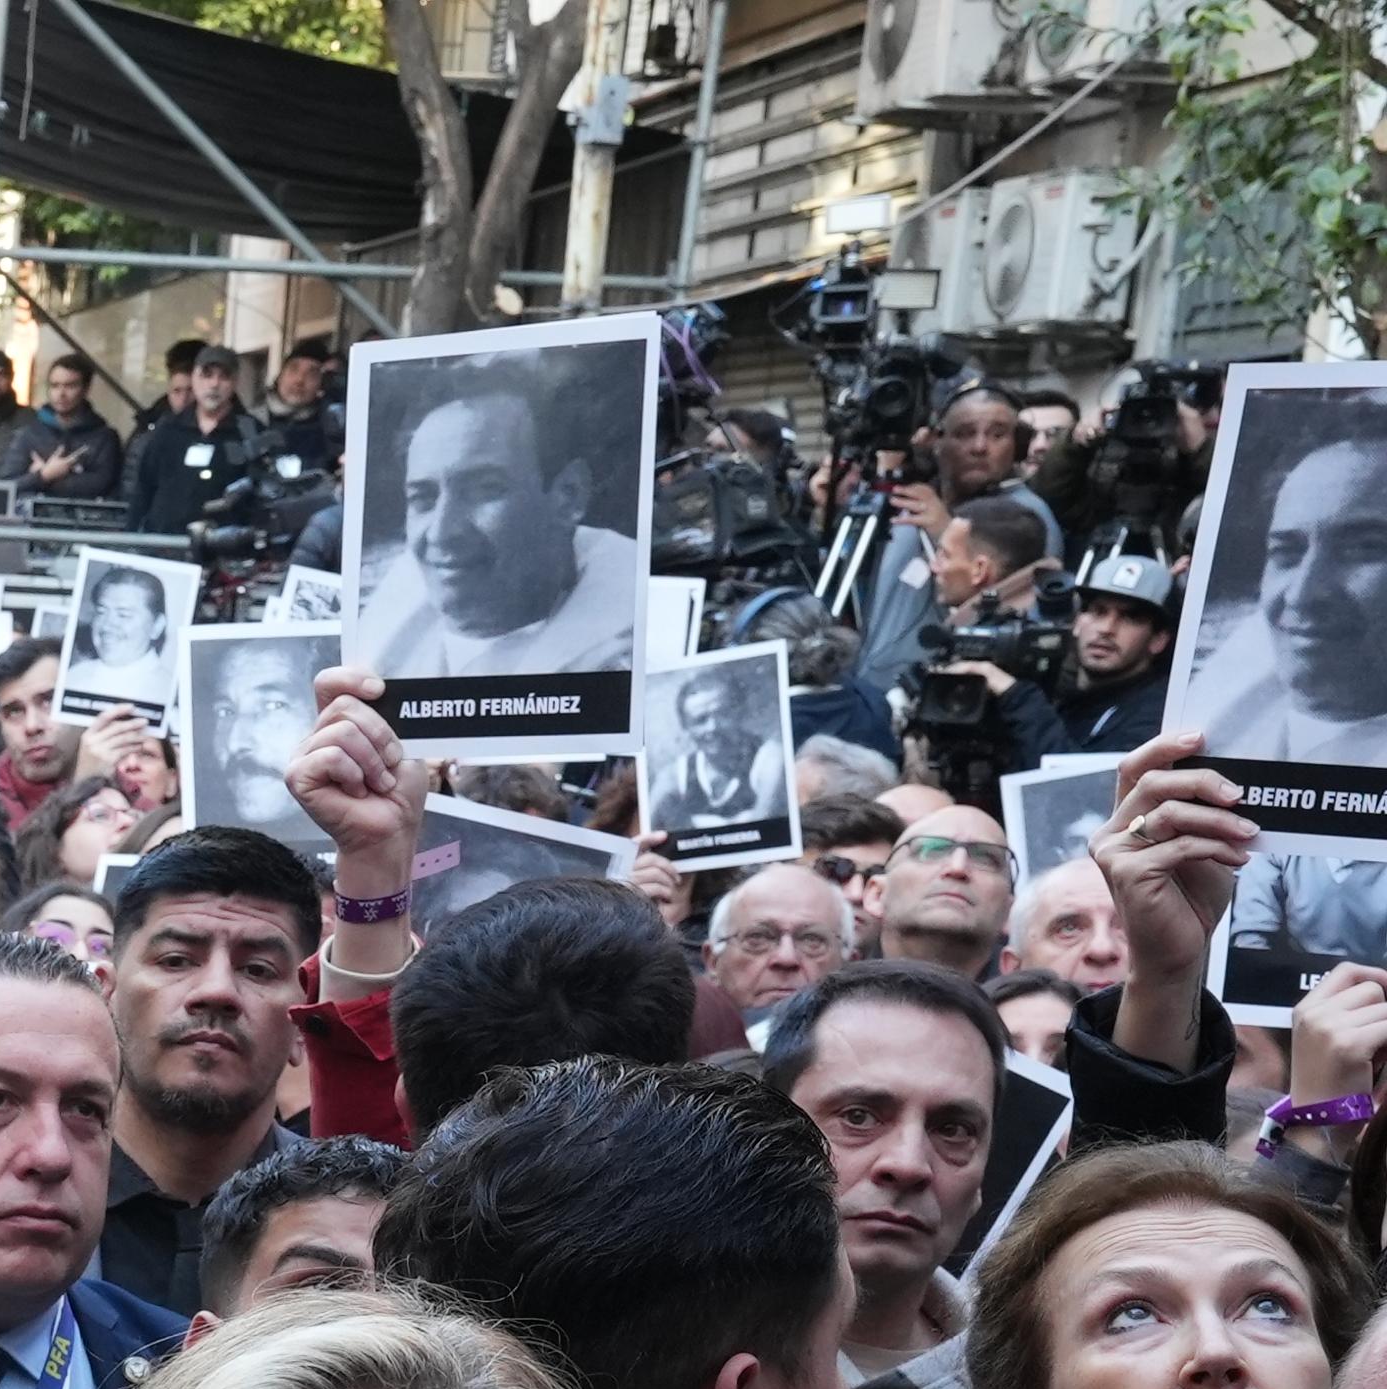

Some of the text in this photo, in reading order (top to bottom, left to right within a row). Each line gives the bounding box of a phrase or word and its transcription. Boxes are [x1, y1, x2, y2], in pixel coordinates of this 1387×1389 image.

[400, 692, 582, 719] ALBERTO FERNÁNDEZ
[45, 1336, 71, 1379] PFA
